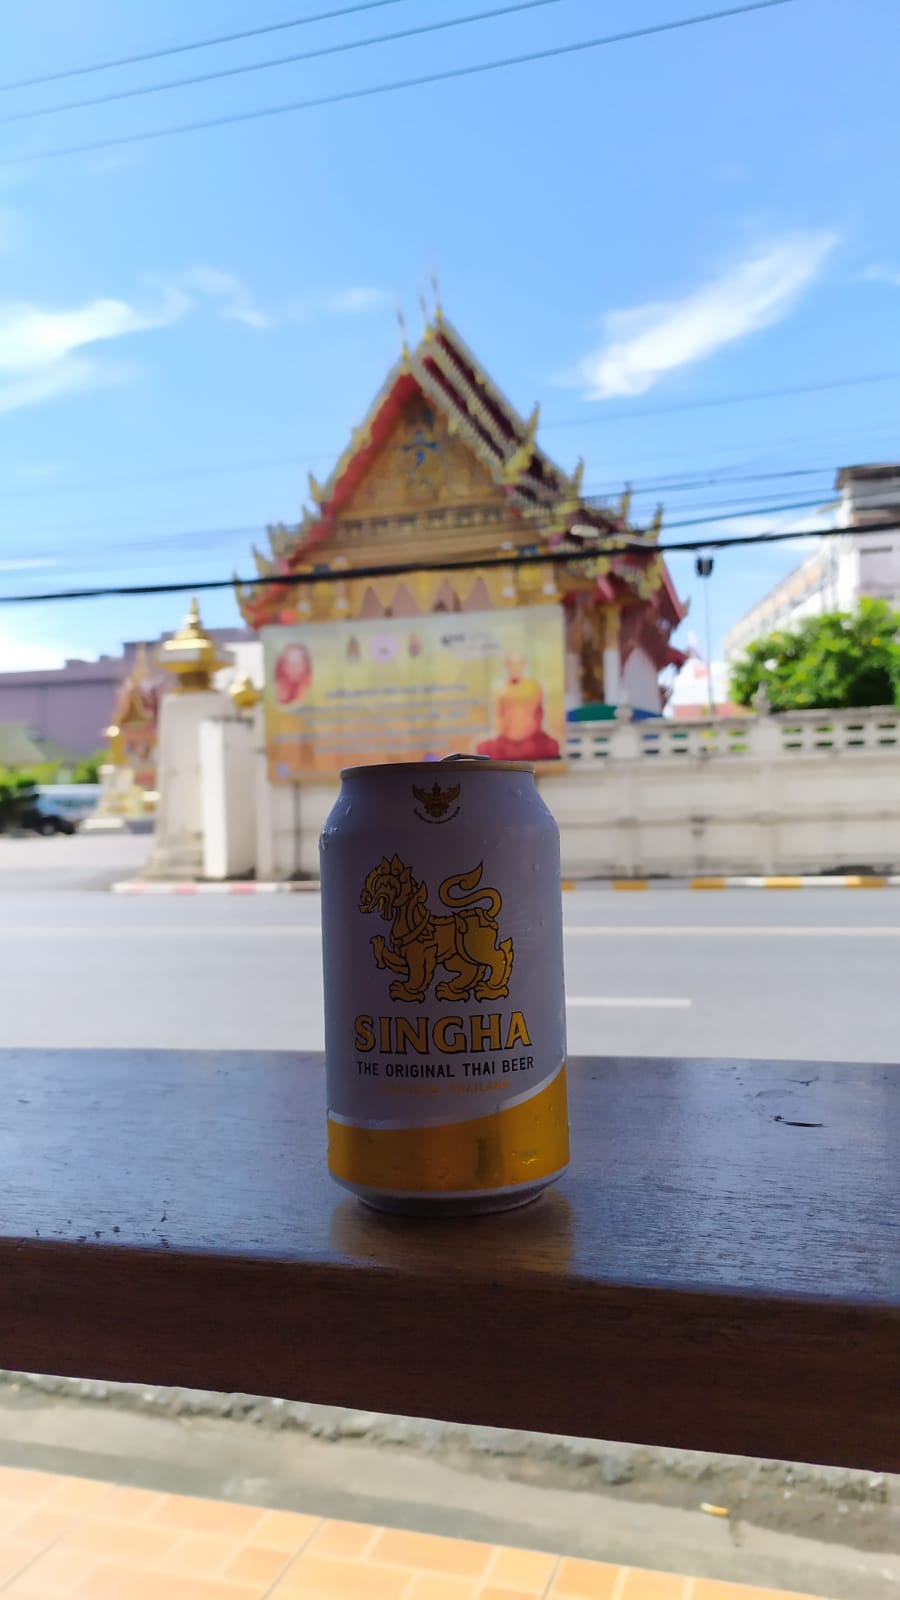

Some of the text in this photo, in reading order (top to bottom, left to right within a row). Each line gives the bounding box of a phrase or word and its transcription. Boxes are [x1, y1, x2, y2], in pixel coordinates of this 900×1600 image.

[354, 1011, 533, 1054] SINGHA
[357, 1056, 534, 1078] THE ORIGINAL THAI BEER
